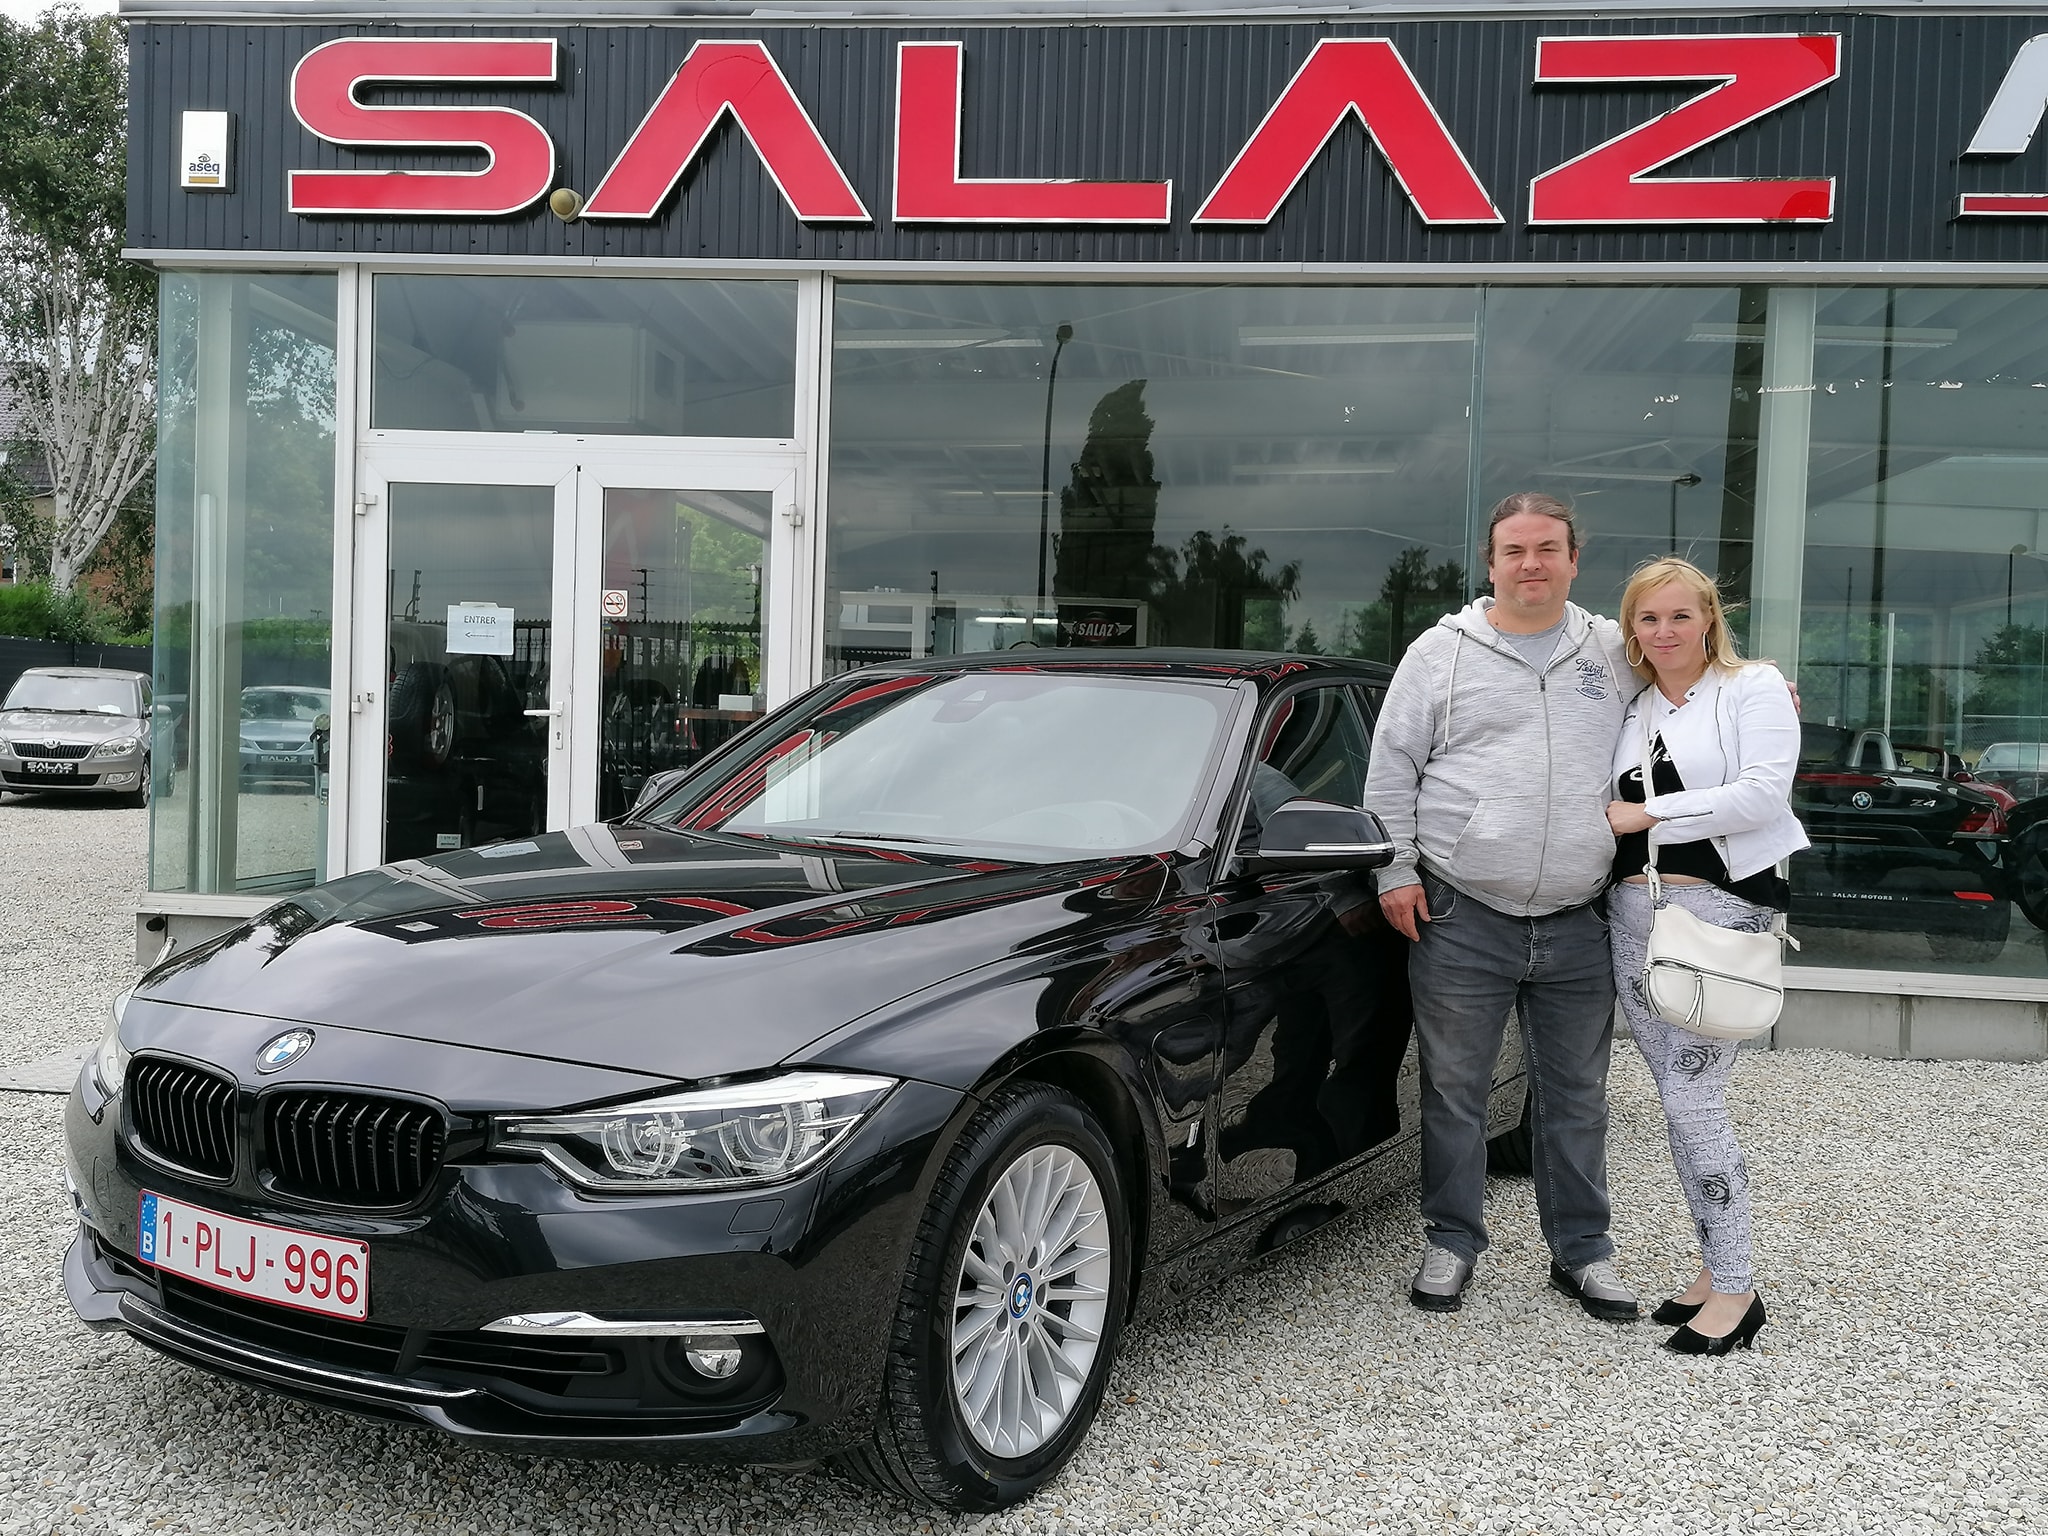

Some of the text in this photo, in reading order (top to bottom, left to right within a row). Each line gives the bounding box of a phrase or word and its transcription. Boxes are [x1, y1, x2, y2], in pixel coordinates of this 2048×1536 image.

[288, 33, 1842, 226] SALAZ
[189, 162, 220, 175] aseq
[463, 615, 496, 625] ENTRER
[1078, 622, 1115, 637] SALAZ
[27, 761, 73, 770] SALAZ
[1909, 799, 1937, 808] Z4
[142, 1230, 153, 1254] B
[163, 1211, 359, 1305] 1-PLJ-996
